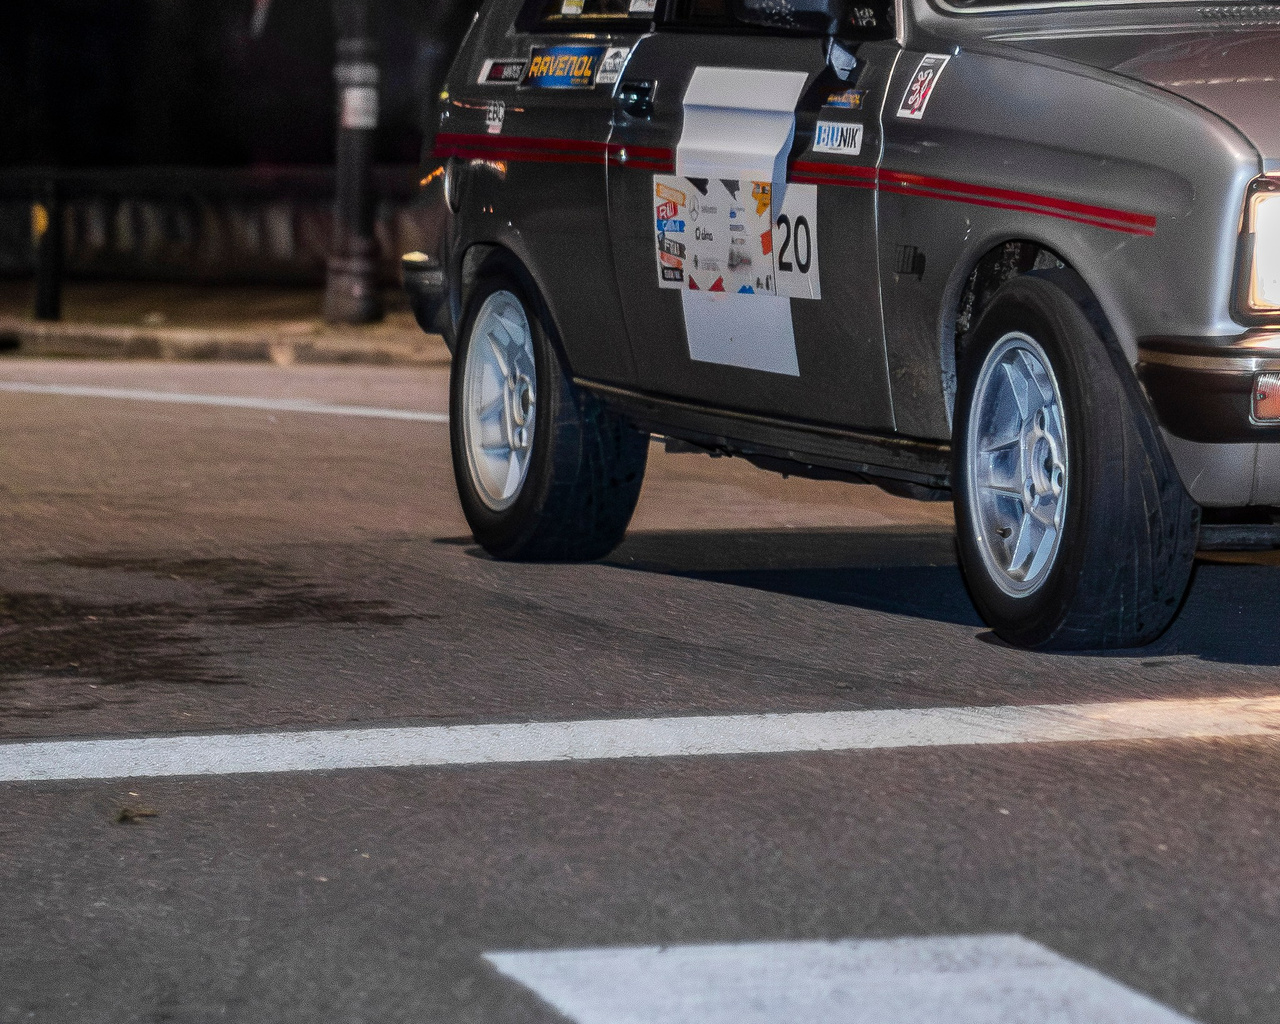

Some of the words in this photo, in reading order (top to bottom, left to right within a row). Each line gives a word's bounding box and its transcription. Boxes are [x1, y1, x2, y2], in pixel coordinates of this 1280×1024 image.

[528, 55, 593, 78] RAVENOL
[816, 125, 860, 149] BLUNIK
[776, 213, 812, 274] 20
